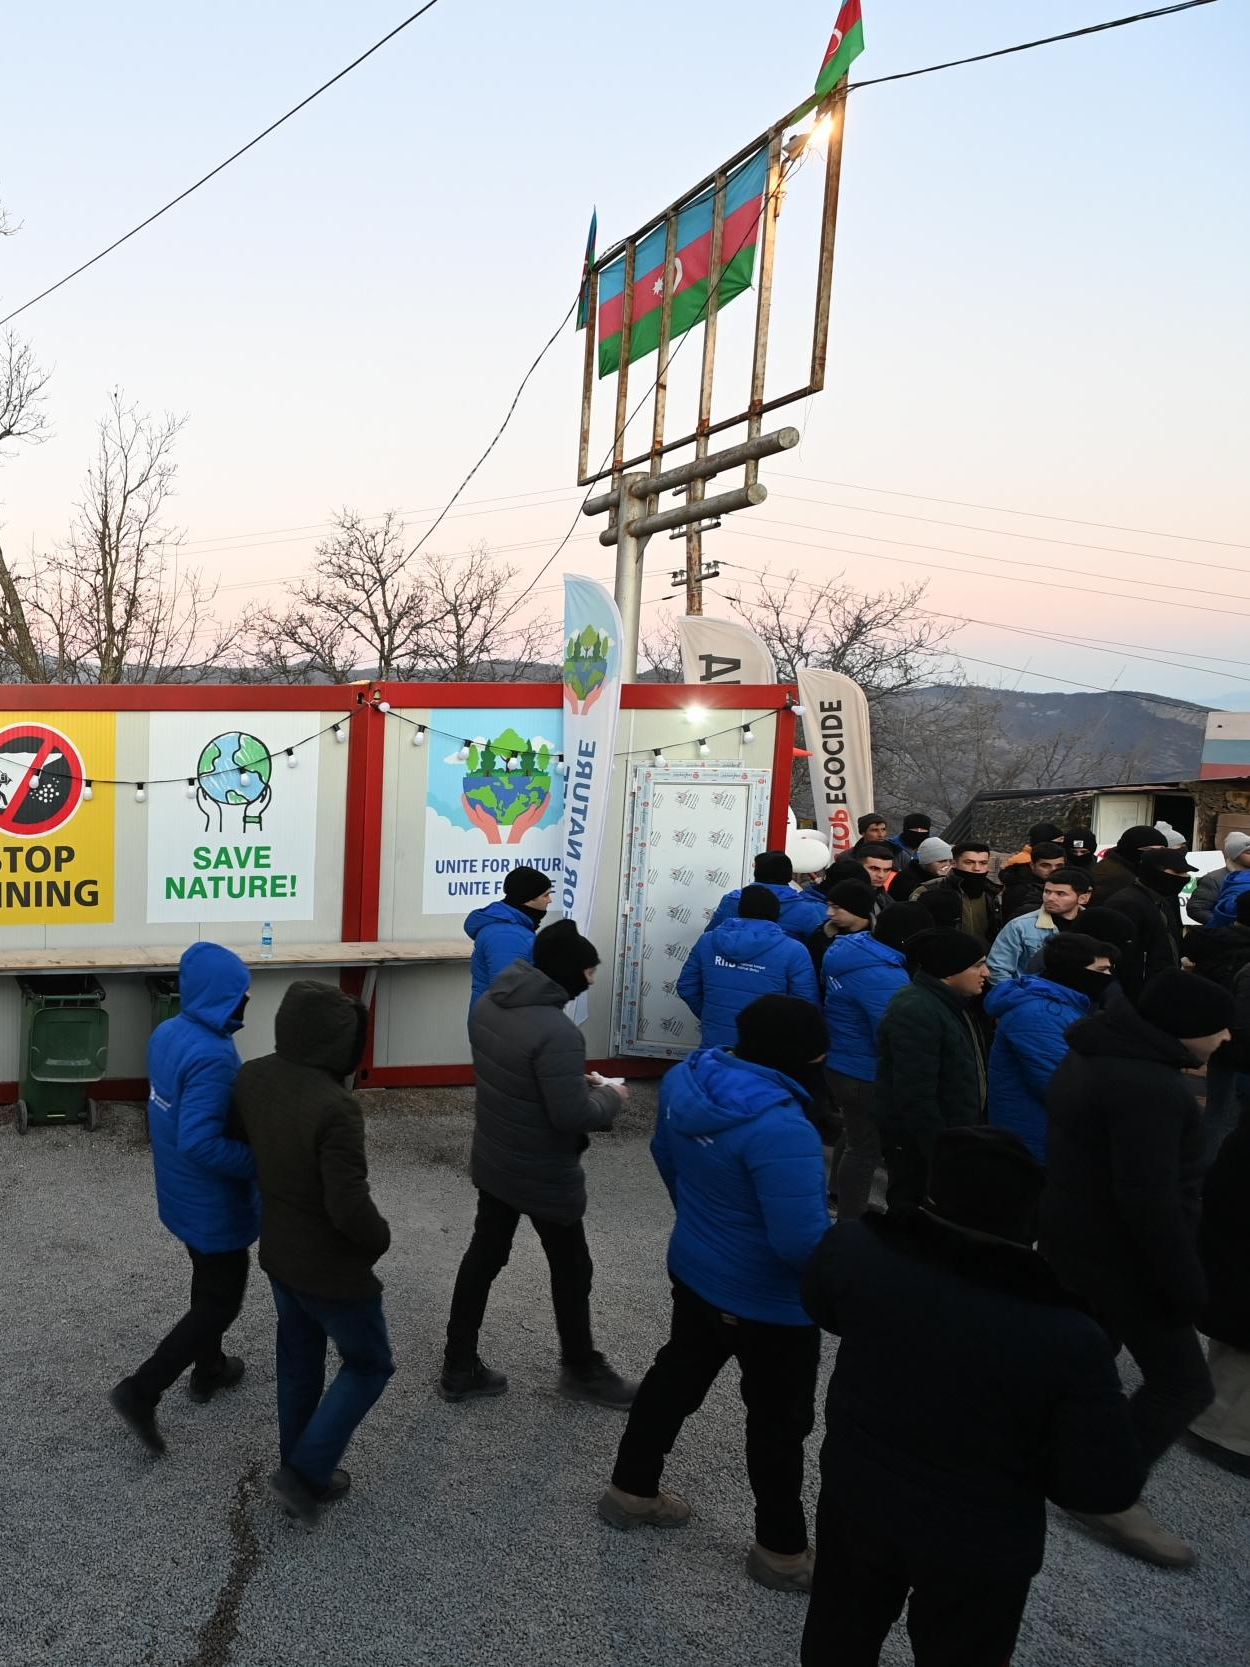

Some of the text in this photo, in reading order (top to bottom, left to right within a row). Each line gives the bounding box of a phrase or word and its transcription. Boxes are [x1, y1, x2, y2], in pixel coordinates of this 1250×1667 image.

[193, 846, 271, 870] SAVE
[435, 859, 478, 874] UNITE
[482, 858, 510, 872] FOR
[165, 875, 297, 900] NATURE!
[448, 881, 490, 896] UNITE
